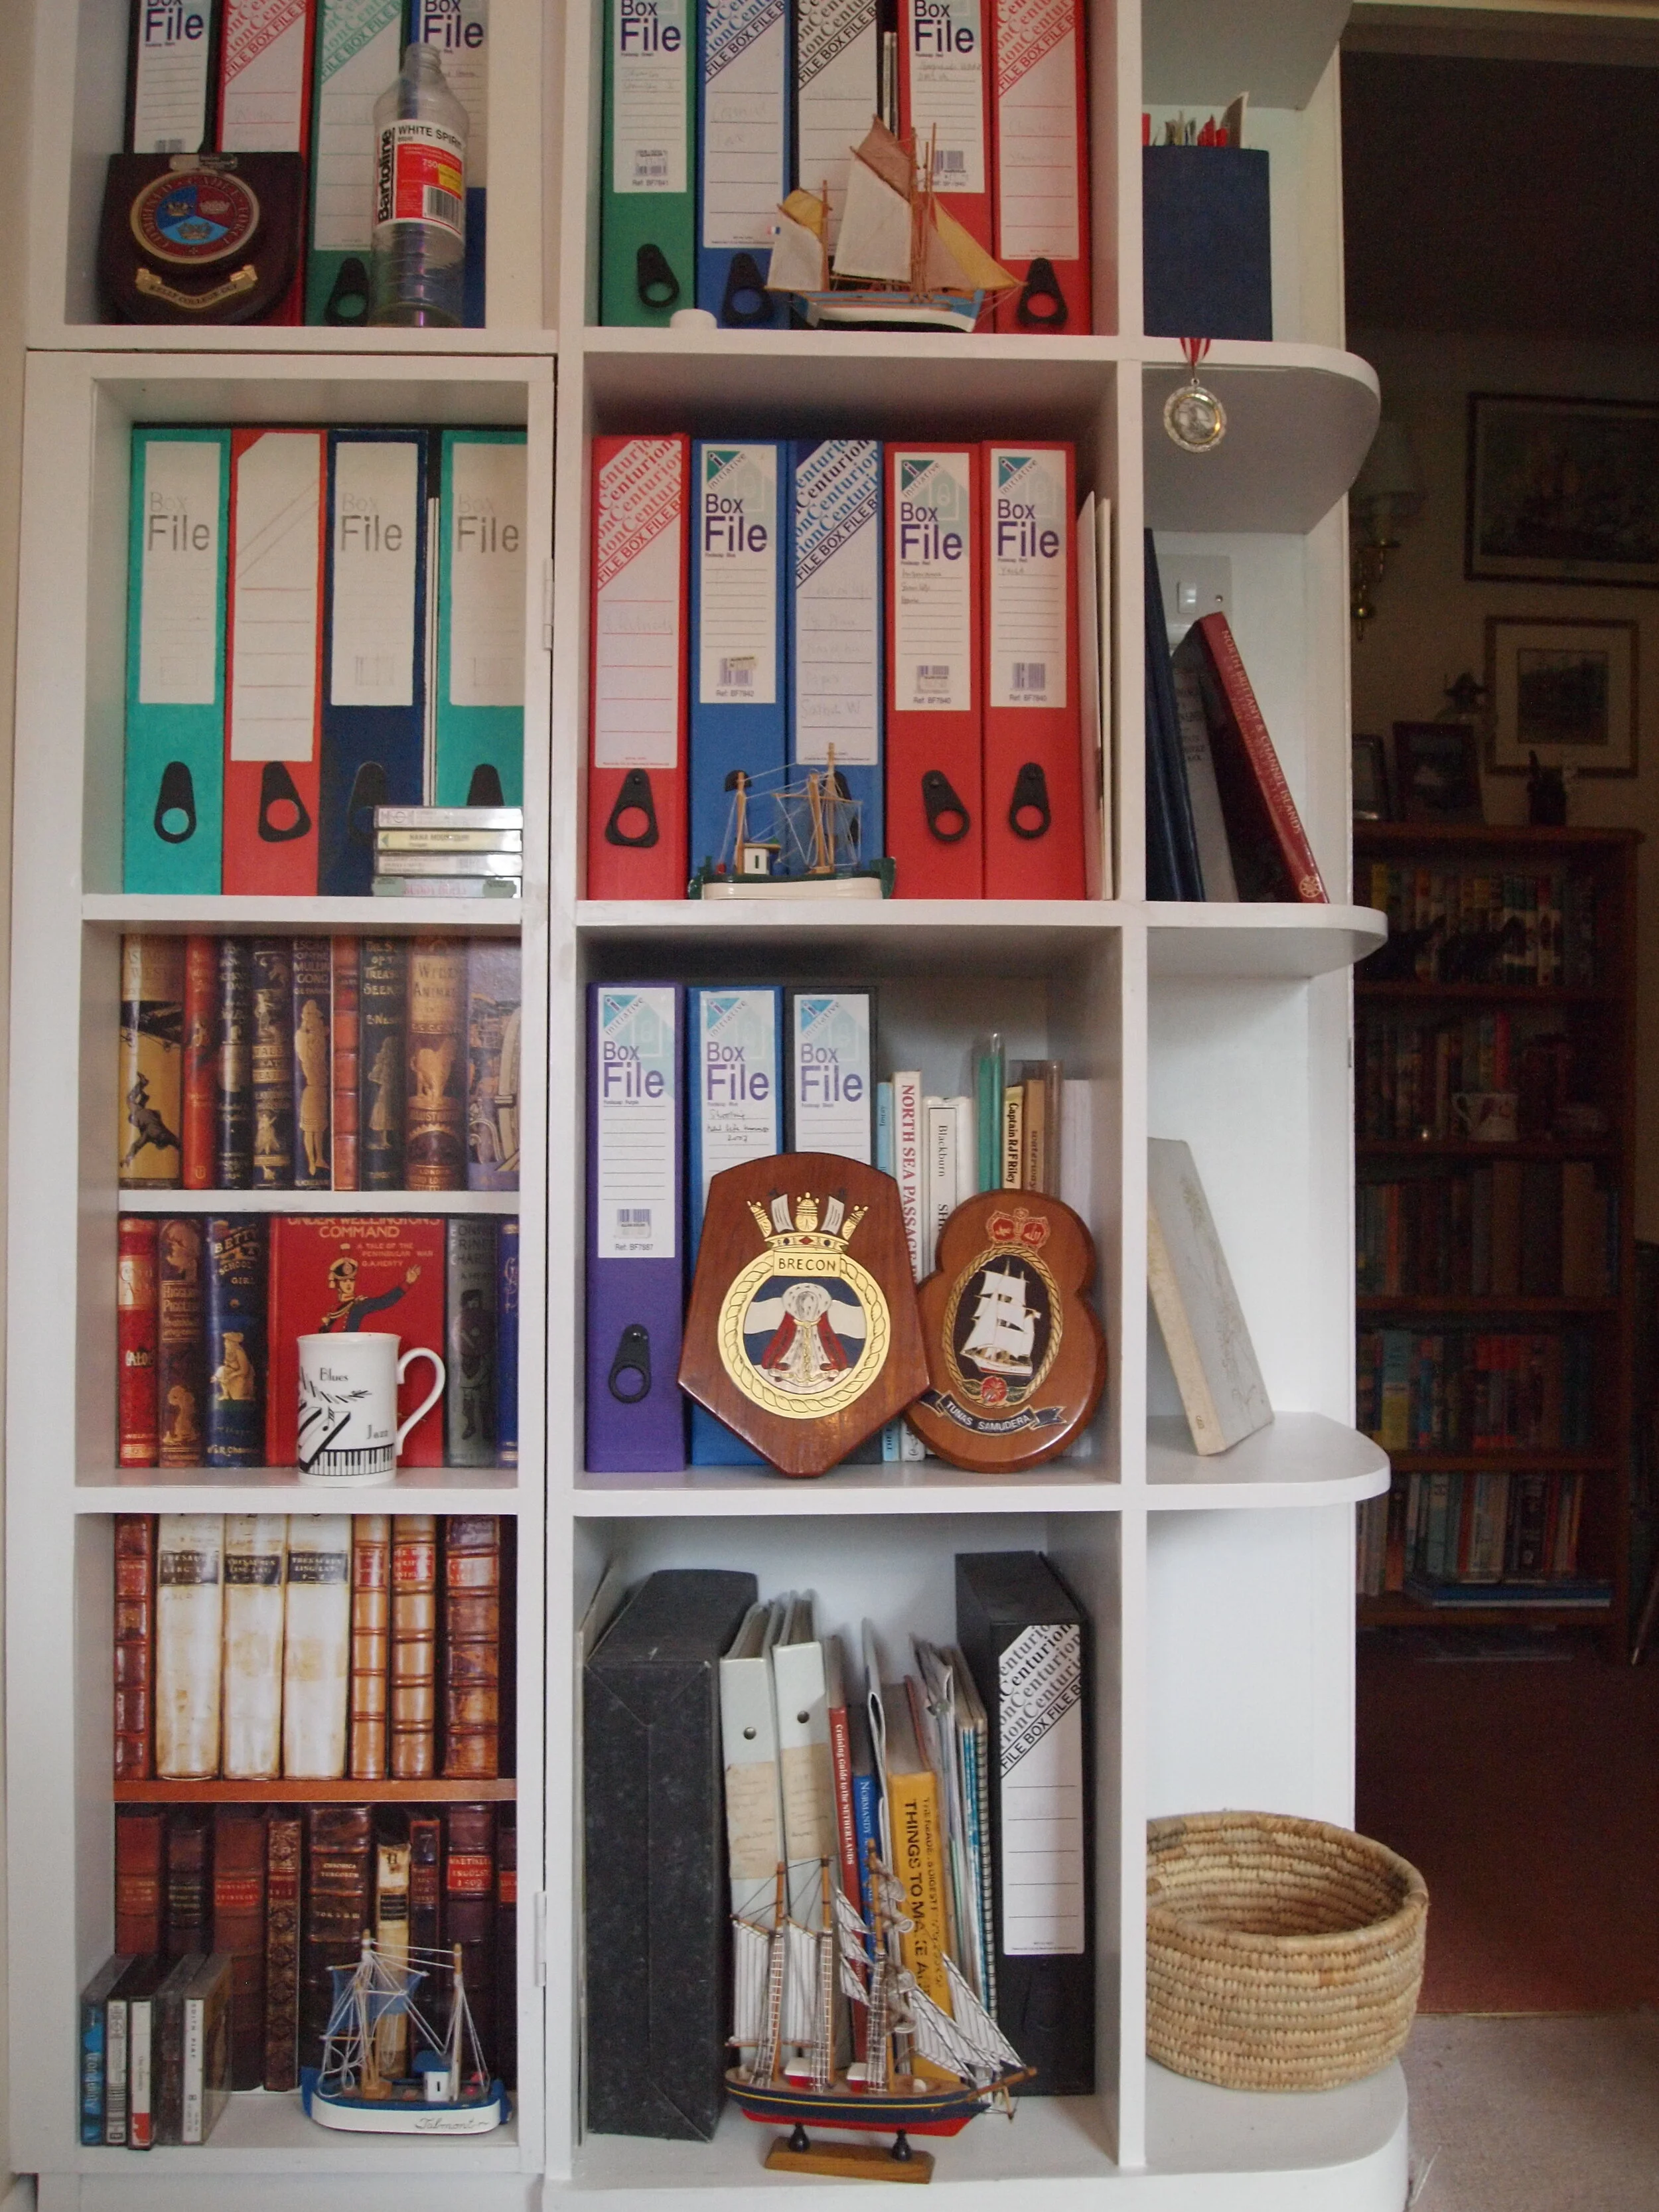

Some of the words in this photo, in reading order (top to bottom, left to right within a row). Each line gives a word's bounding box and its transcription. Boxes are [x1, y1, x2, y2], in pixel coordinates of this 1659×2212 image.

[145, 7, 204, 41] File
[425, 0, 461, 13] Box
[620, 0, 658, 16] Box
[914, 0, 950, 18] Box
[226, 50, 251, 78] FILE
[250, 29, 274, 54] BOX
[272, 9, 298, 33] FILE
[322, 50, 346, 78] FILE
[344, 29, 368, 54] BOX
[368, 11, 392, 34] FILE
[423, 14, 484, 48] File
[620, 18, 681, 52] File
[706, 52, 731, 76] FILE
[729, 31, 754, 54] BOX
[753, 9, 778, 33] FILE
[914, 19, 974, 54] File
[798, 58, 824, 83] FILE
[823, 37, 846, 61] BOX
[843, 16, 867, 41] FILE
[997, 66, 1023, 90] FILE
[1021, 45, 1046, 68] BOX
[1044, 23, 1068, 48] FILE
[398, 125, 433, 137] WHITE
[378, 129, 392, 223] Bartoline
[708, 453, 747, 490] initiative
[903, 461, 940, 498] initiative
[1001, 459, 1037, 495] initiative
[149, 492, 187, 512] Box
[342, 492, 378, 512] Box
[458, 492, 493, 513] Box
[705, 493, 743, 514] Box
[901, 502, 939, 522] Box
[997, 498, 1036, 519] Box
[147, 514, 211, 552] File
[340, 516, 403, 552] File
[457, 516, 520, 554] File
[597, 556, 624, 584] FILE
[621, 532, 648, 559] BOX
[646, 507, 673, 535] FILE
[704, 516, 768, 552] File
[797, 553, 822, 580] FILE
[819, 530, 845, 556] BOX
[843, 505, 871, 533] FILE
[901, 524, 962, 561] File
[997, 521, 1060, 558] File
[1220, 628, 1242, 668] NORTH
[1235, 669, 1262, 721] BRITTANY
[1254, 723, 1265, 733] &
[1258, 734, 1285, 786] CHANNEL
[1278, 789, 1304, 835] ISLANDS
[605, 998, 645, 1036] initiative
[709, 1000, 748, 1038] initiative
[804, 1001, 841, 1039] initiative
[603, 1041, 640, 1061] Box
[706, 1041, 745, 1062] Box
[800, 1043, 839, 1063] Box
[603, 1062, 664, 1098] File
[706, 1064, 770, 1101] File
[801, 1065, 863, 1102] File
[901, 1084, 916, 1143] NORTH
[1007, 1102, 1019, 1138] Captain
[902, 1147, 916, 1181] SEA
[938, 1125, 948, 1177] Blackburn
[1006, 1161, 1018, 1183] Riley
[319, 1226, 400, 1238] COMMAND
[902, 1185, 917, 1260] PASSAGE
[214, 1228, 255, 1254] BETTY
[778, 1258, 836, 1271] BRECON
[319, 1367, 349, 1382] Blues
[366, 1424, 389, 1439] Jazz
[946, 1400, 974, 1426] TUNAS
[977, 1415, 1031, 1431] SAMUDERA
[832, 1724, 847, 1757] Cruising
[1000, 1741, 1027, 1770] FILE
[1023, 1718, 1050, 1745] BOX
[1047, 1693, 1073, 1720] FILE
[836, 1758, 848, 1781] Guide
[839, 1781, 849, 1791] to
[839, 1790, 850, 1803] the
[857, 1781, 874, 1834] NORMANDY
[419, 1834, 433, 1852] 7
[839, 1803, 856, 1865] NETHERLANDS
[903, 1799, 921, 1869] THINGS
[909, 1872, 923, 1897] TO
[414, 2116, 478, 2130] Talmont
